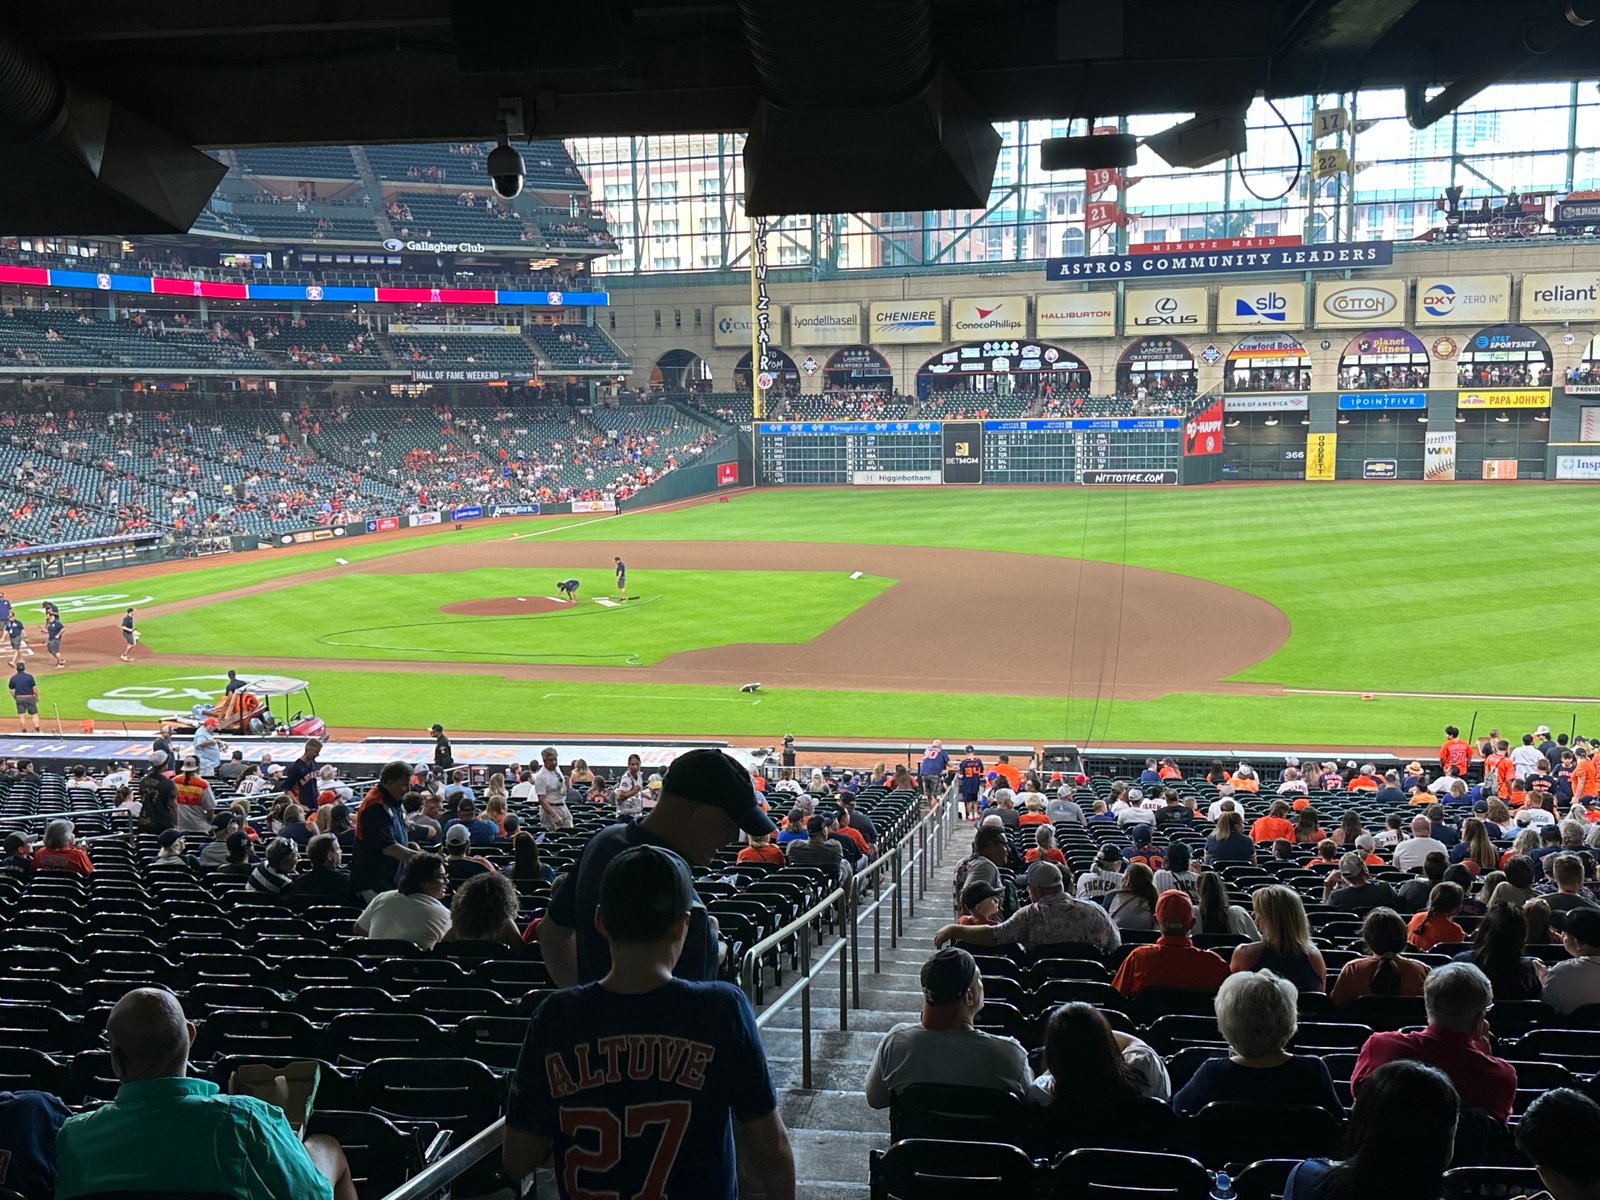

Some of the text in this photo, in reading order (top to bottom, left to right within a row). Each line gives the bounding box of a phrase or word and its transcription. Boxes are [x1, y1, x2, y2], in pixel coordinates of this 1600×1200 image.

[1321, 114, 1339, 130] 17
[1318, 156, 1336, 170] 22
[1093, 170, 1110, 185] 19
[1091, 206, 1107, 221] 21
[406, 241, 486, 253] Gallagher Club
[1153, 239, 1276, 251] MINUTE MAID
[1060, 248, 1376, 276] ASTROS COMMUNITY LEADERS
[1462, 295, 1486, 304] ZERO
[1534, 286, 1597, 302] reliant
[1256, 292, 1286, 310] slb
[1333, 296, 1385, 312] COTTON
[1424, 296, 1456, 304] OXY
[876, 311, 936, 322] CHENIERE
[1041, 311, 1111, 320] HALLIBURTON
[1562, 307, 1596, 316] company
[794, 314, 858, 328] lyondellbasell
[956, 320, 1022, 330] ConocoPhillips
[1134, 314, 1198, 326] LEXUS
[758, 316, 769, 371] FAIR
[1238, 342, 1276, 350] Crawford
[1373, 338, 1405, 348] planet
[1489, 340, 1538, 348] SPORTSNET
[416, 371, 434, 379] HALL
[446, 371, 464, 379] FAME
[466, 372, 499, 380] WEEKEND
[1350, 397, 1415, 406] 1POINTFIVE
[1489, 395, 1546, 405] PAPA JOHN'S
[1095, 473, 1164, 483] NITTOTIRE.COM
[494, 504, 534, 518] AmegyBank
[964, 767, 980, 777] 34
[241, 782, 253, 794] 30
[1326, 779, 1342, 790] 27
[1084, 880, 1116, 890] TUCKER
[1173, 880, 1197, 890] TUCK
[545, 1034, 715, 1098] ALTUVE
[559, 1100, 692, 1200] 27
